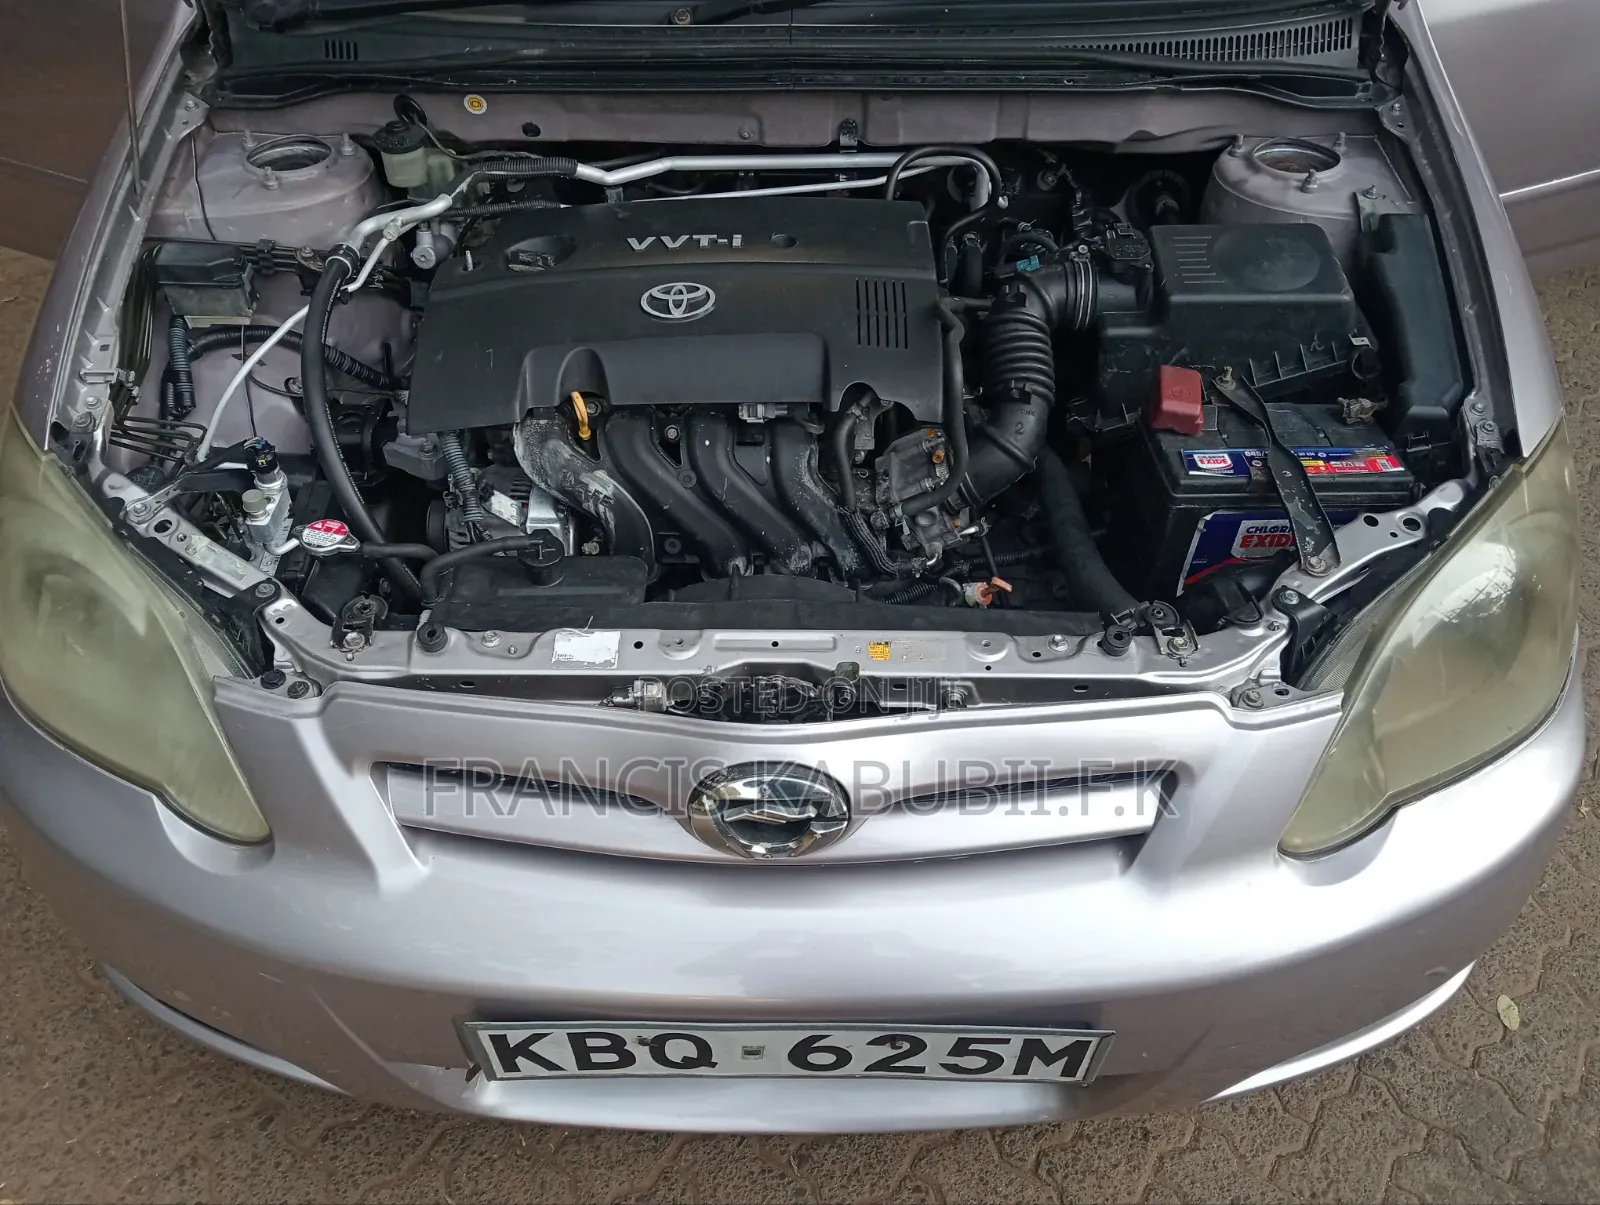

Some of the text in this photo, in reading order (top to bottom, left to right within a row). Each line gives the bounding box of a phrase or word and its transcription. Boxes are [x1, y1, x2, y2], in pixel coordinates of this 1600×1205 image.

[626, 234, 742, 251] VVT-i
[487, 1031, 1093, 1078] KBQ 625M
